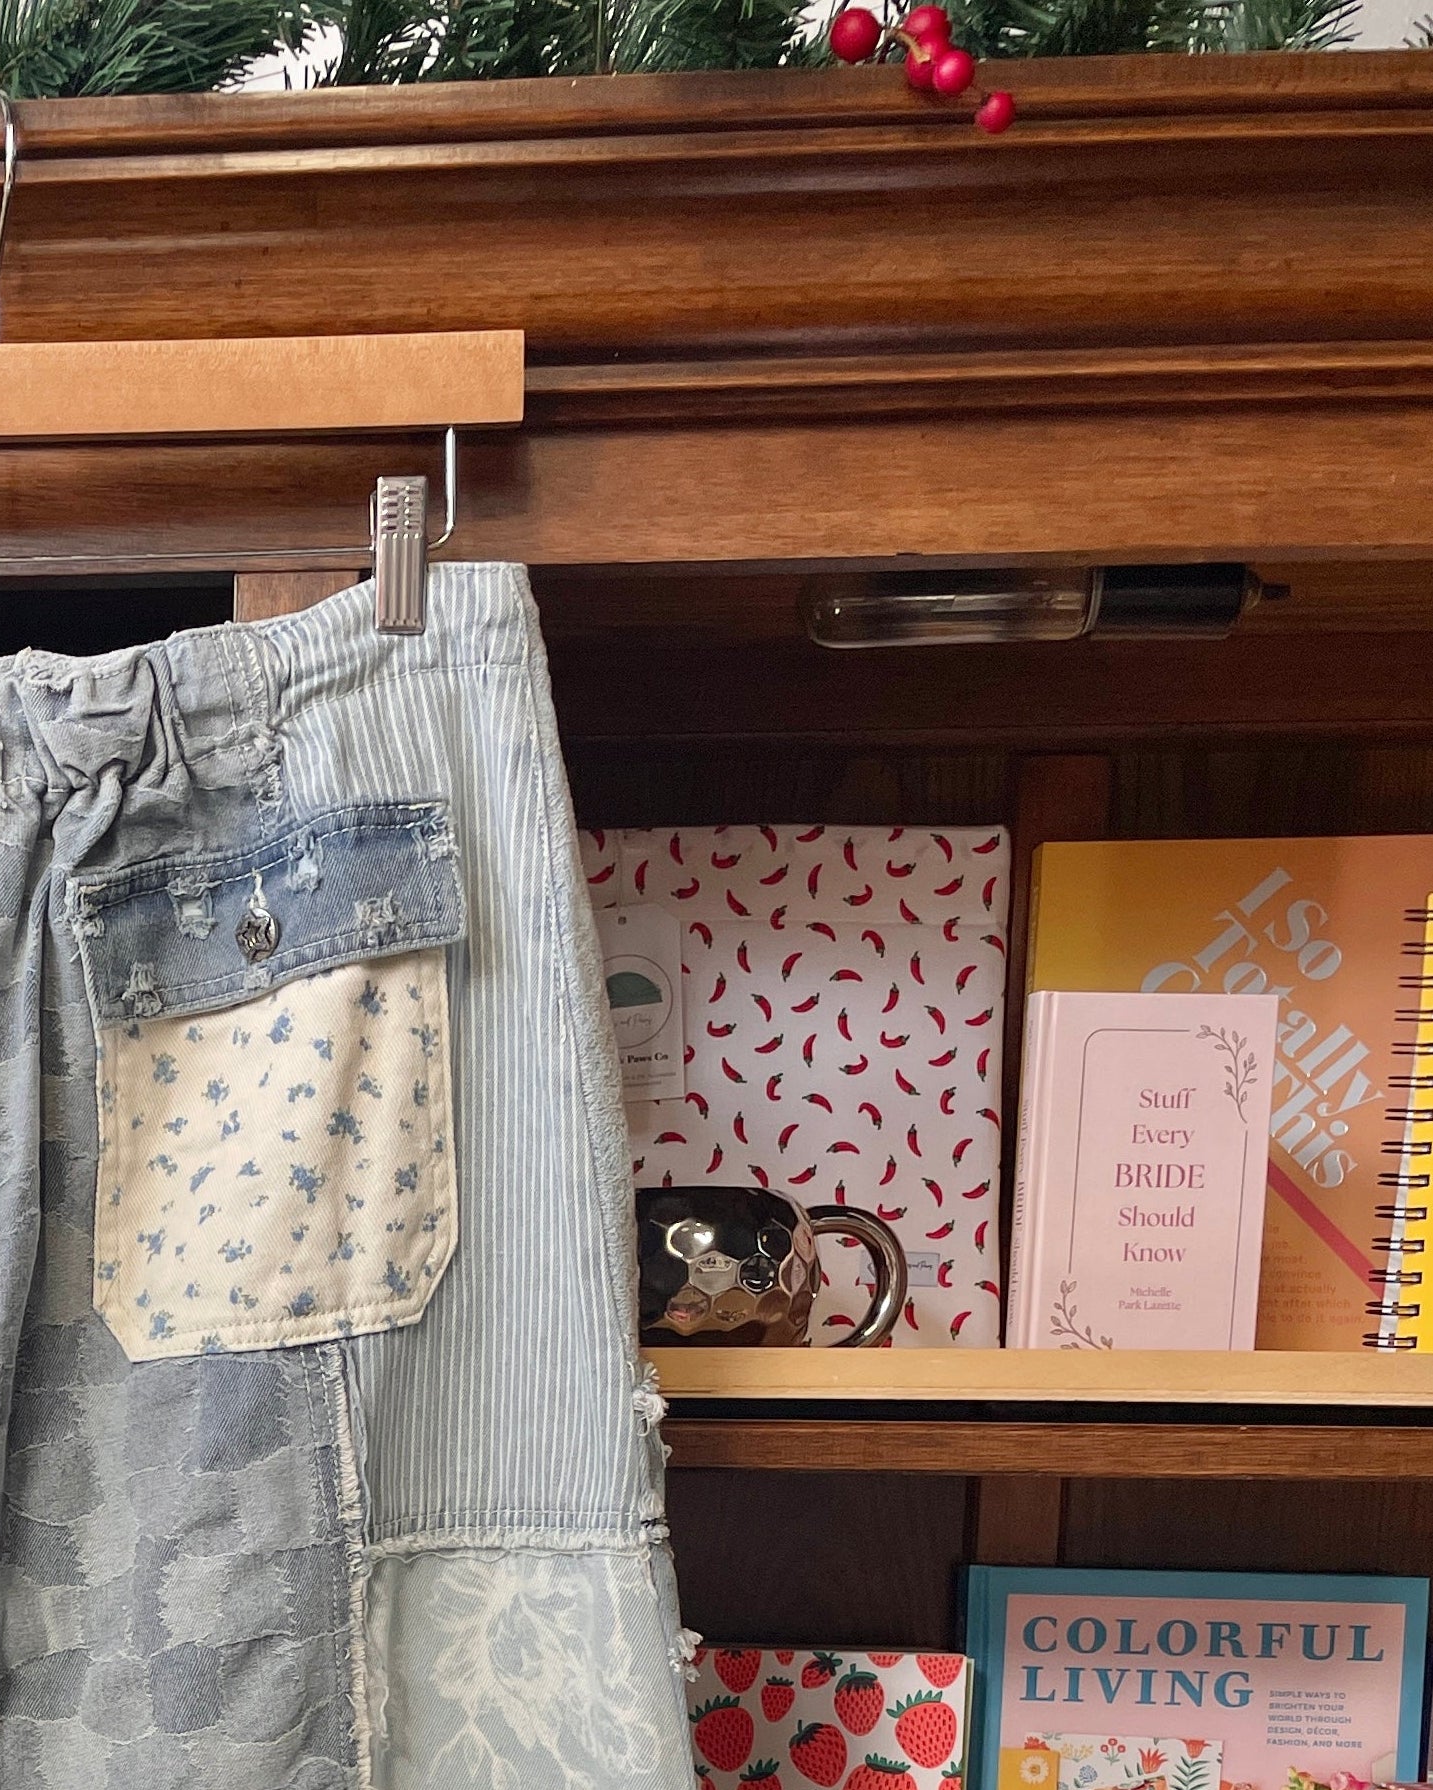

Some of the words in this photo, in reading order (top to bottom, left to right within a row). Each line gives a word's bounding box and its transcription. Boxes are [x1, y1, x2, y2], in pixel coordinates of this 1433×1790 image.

[1237, 866, 1294, 918] I
[1263, 899, 1343, 981] So
[1192, 909, 1385, 1117] Toally
[1139, 1087, 1197, 1109] Stuff
[1131, 1123, 1196, 1149] Every
[1114, 1163, 1206, 1189] BRIDE
[1118, 1205, 1196, 1228] Should
[1122, 1241, 1187, 1263] Know
[1129, 1286, 1173, 1299] Michelle
[1118, 1300, 1142, 1311] Park
[1022, 1616, 1385, 1662] COLORFUL
[1019, 1665, 1254, 1708] LIVING
[1269, 1690, 1302, 1698] SIMPLE
[1304, 1691, 1331, 1699] WAYS
[1268, 1714, 1302, 1722] WORLD
[1304, 1715, 1352, 1723] THROUGH
[1267, 1726, 1304, 1735] DESIGN,
[1266, 1738, 1310, 1747] FASHION,
[1312, 1740, 1333, 1748] AND
[1335, 1741, 1363, 1749] MORE
